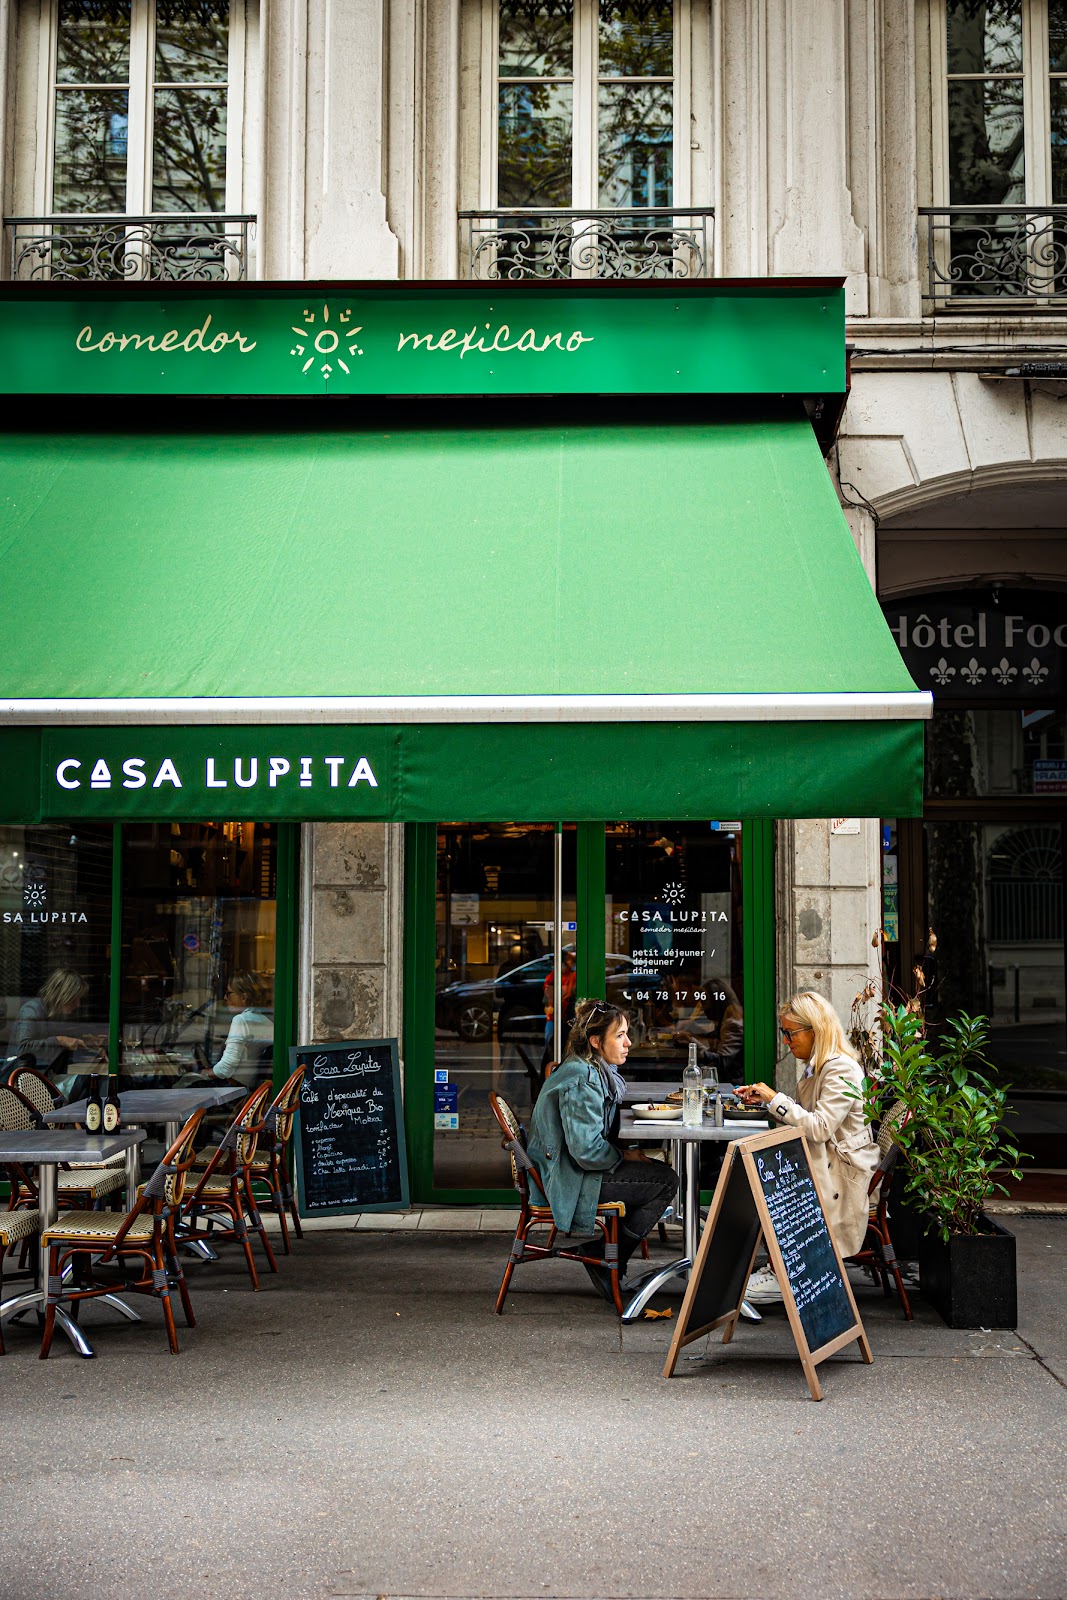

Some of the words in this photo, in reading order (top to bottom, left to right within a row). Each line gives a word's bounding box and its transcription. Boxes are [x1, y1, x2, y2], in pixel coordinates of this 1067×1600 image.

[76, 314, 256, 353] comedor
[397, 323, 594, 359] mexicano
[891, 612, 987, 648] Hôtel
[56, 758, 183, 789] CASA
[205, 757, 378, 788] LUPITA
[31, 912, 88, 923] LUPITA
[619, 911, 662, 921] CASA
[670, 911, 728, 922] LUPITA
[640, 925, 672, 933] comedor
[673, 926, 707, 934] mexicano
[632, 949, 659, 957] petit
[663, 949, 705, 958] déjeuner
[632, 958, 674, 967] déjeuner
[632, 967, 659, 975] dîner
[636, 991, 650, 1001] 04
[656, 991, 669, 1001] 78
[675, 991, 688, 1001] 17
[694, 991, 707, 1001] 96
[713, 991, 726, 1001] 16
[313, 1055, 340, 1076] Casa
[343, 1052, 382, 1076] Lupita
[301, 1092, 319, 1104] Café
[372, 1087, 384, 1097] du
[324, 1102, 364, 1120] Mexique
[365, 1099, 384, 1113] Bio
